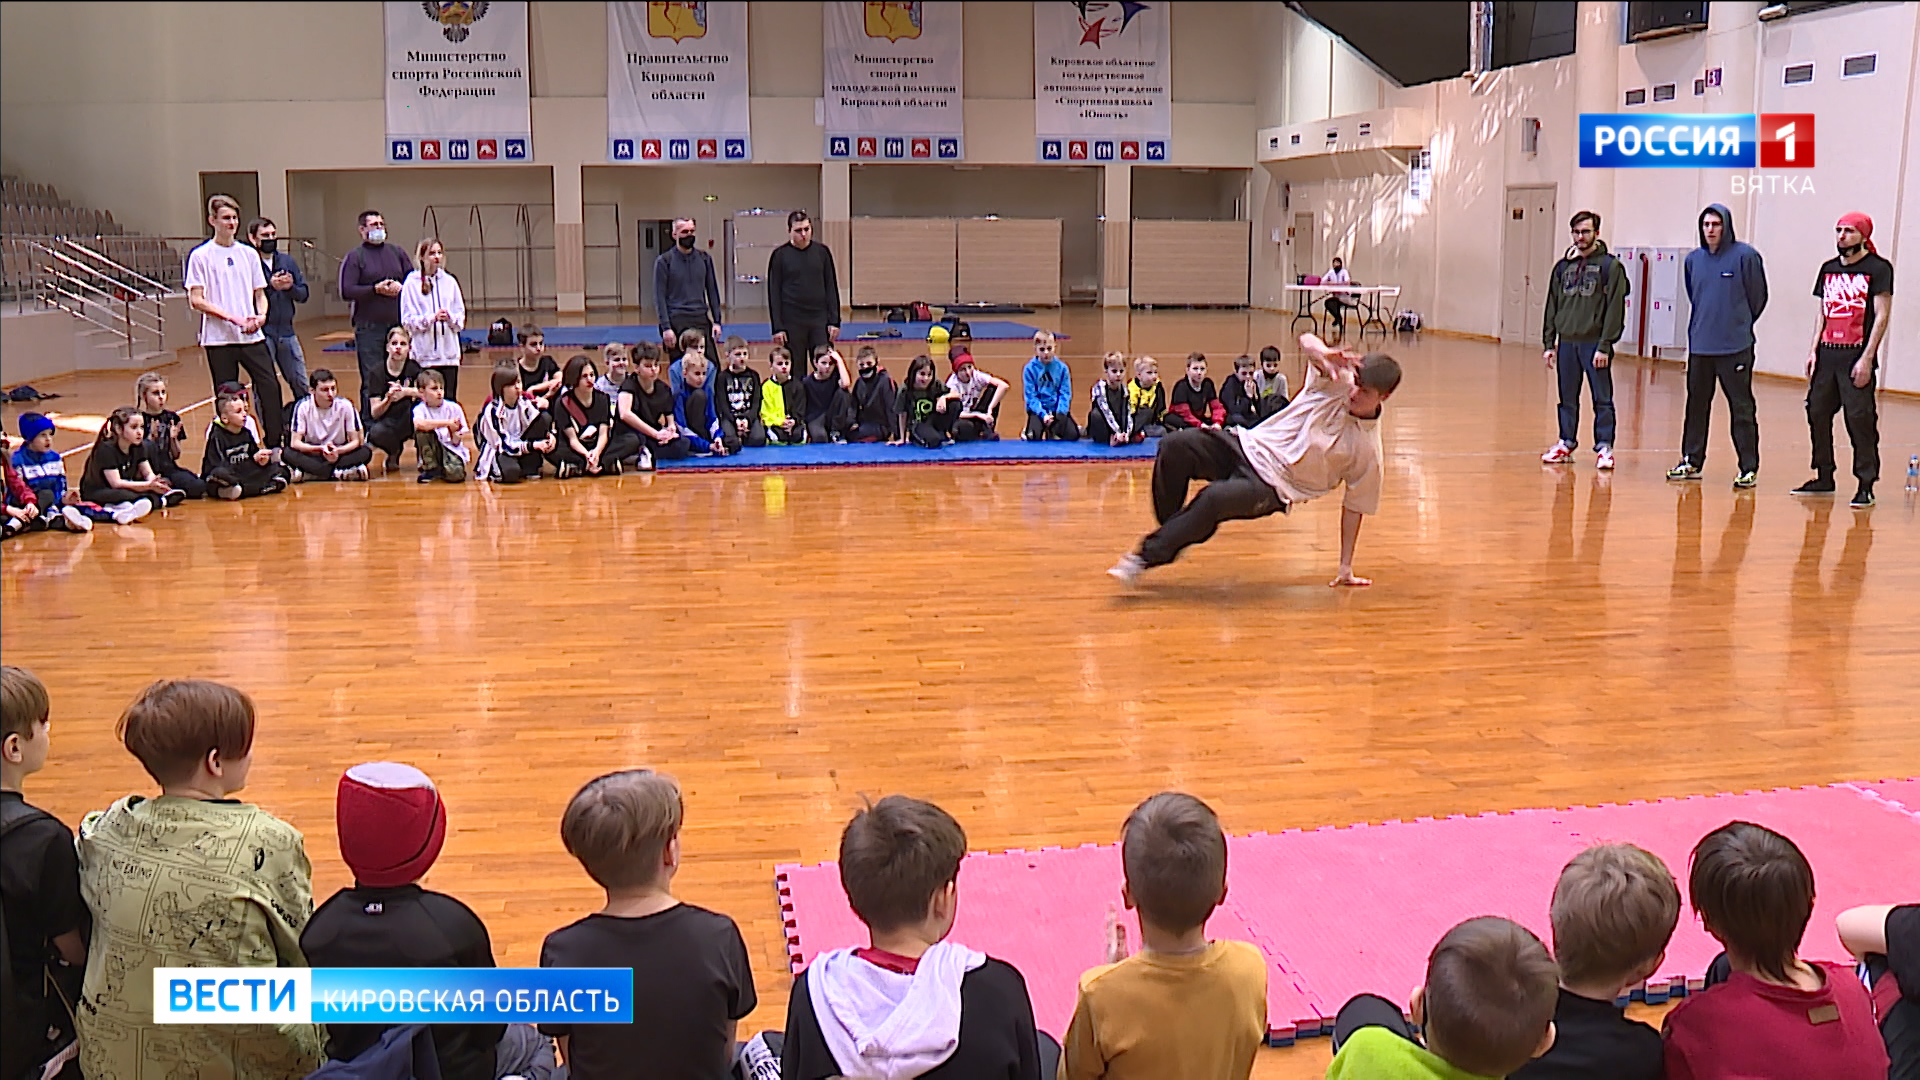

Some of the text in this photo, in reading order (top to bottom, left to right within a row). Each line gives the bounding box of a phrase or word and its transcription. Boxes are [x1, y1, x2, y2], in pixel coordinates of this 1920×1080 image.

[407, 51, 507, 64] Министерство
[627, 53, 729, 66] Правительство
[854, 54, 934, 66] Министерство
[1050, 56, 1156, 67] Кировское областное
[391, 67, 522, 82] спорта Российской
[641, 71, 715, 84] Кировской
[869, 71, 908, 80] спорта
[418, 85, 496, 99] Федерации
[651, 89, 706, 101] области
[831, 84, 957, 94] молодежной политики
[1043, 84, 1164, 94] автономное учреждение
[841, 97, 947, 108] Кировской области
